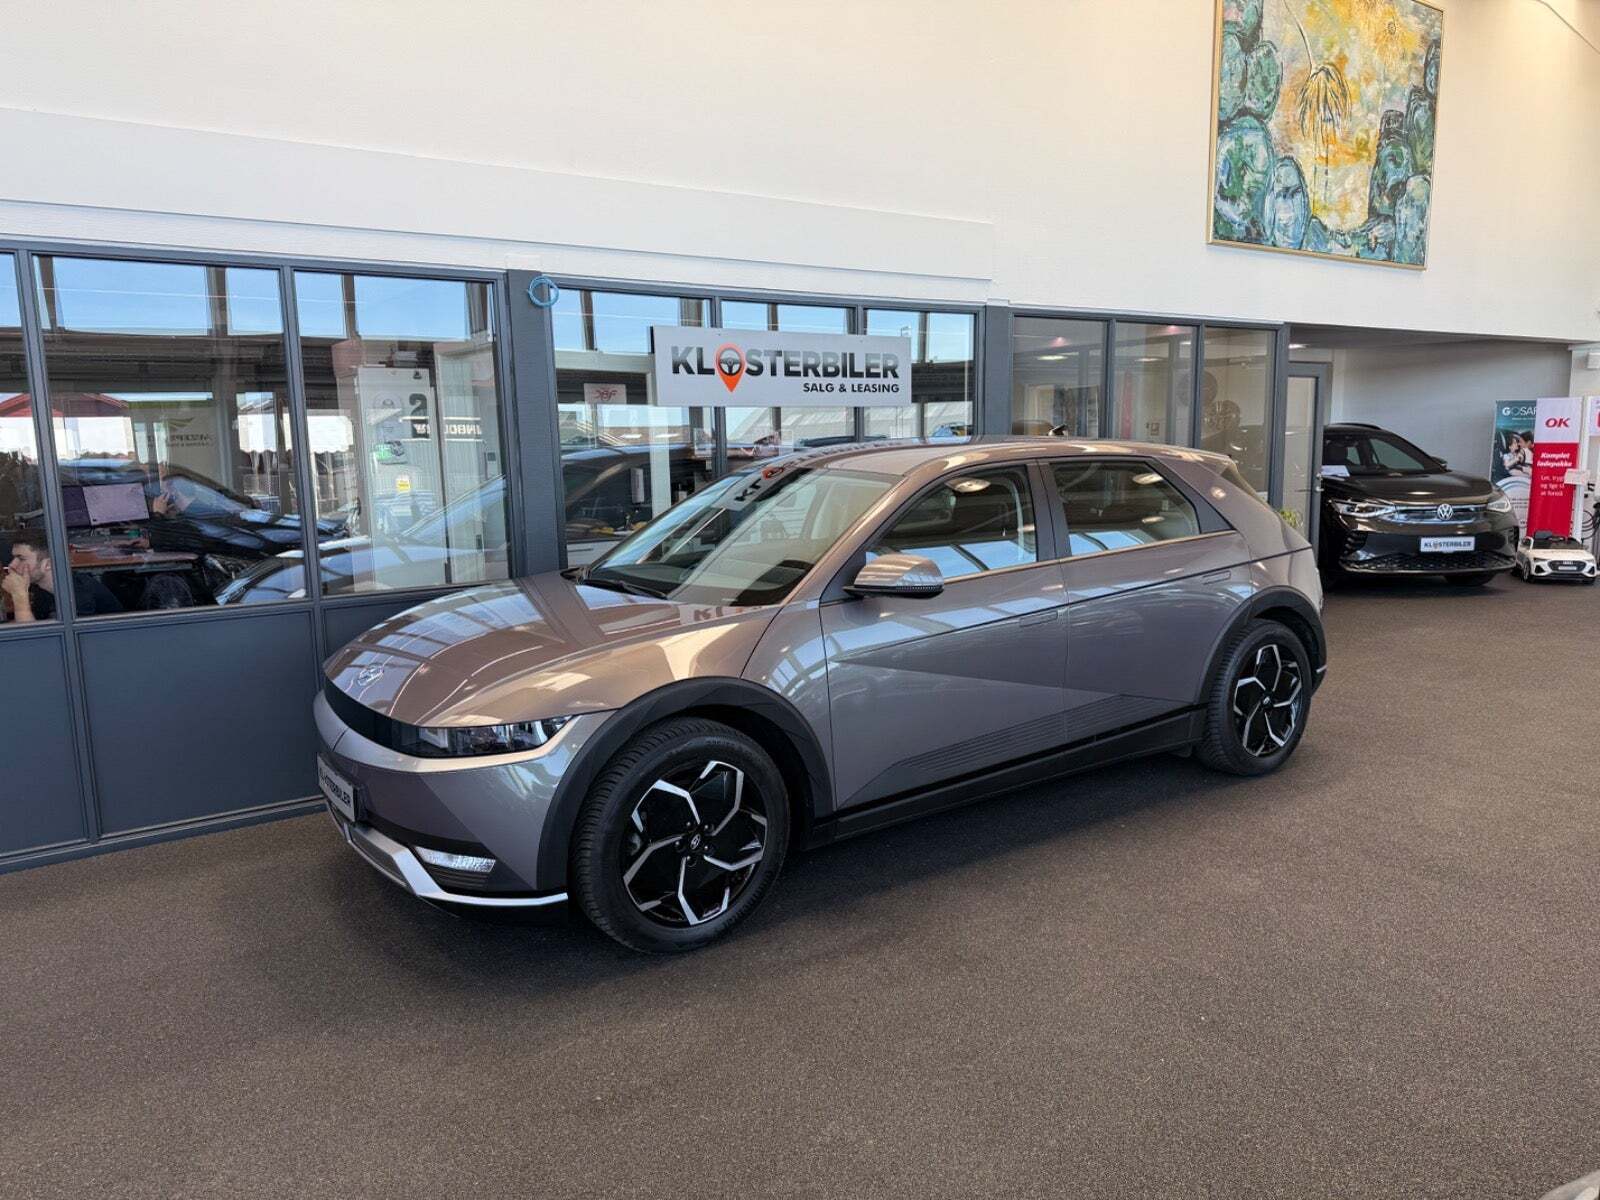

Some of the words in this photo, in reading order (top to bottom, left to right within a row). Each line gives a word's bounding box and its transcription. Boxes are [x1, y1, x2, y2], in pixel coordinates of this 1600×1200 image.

[671, 343, 900, 382] KLOSTERBILER
[803, 382, 835, 393] SALG
[838, 383, 848, 393] &
[851, 383, 900, 393] LEASING
[1545, 417, 1571, 428] OK
[1540, 452, 1570, 460] Komplet
